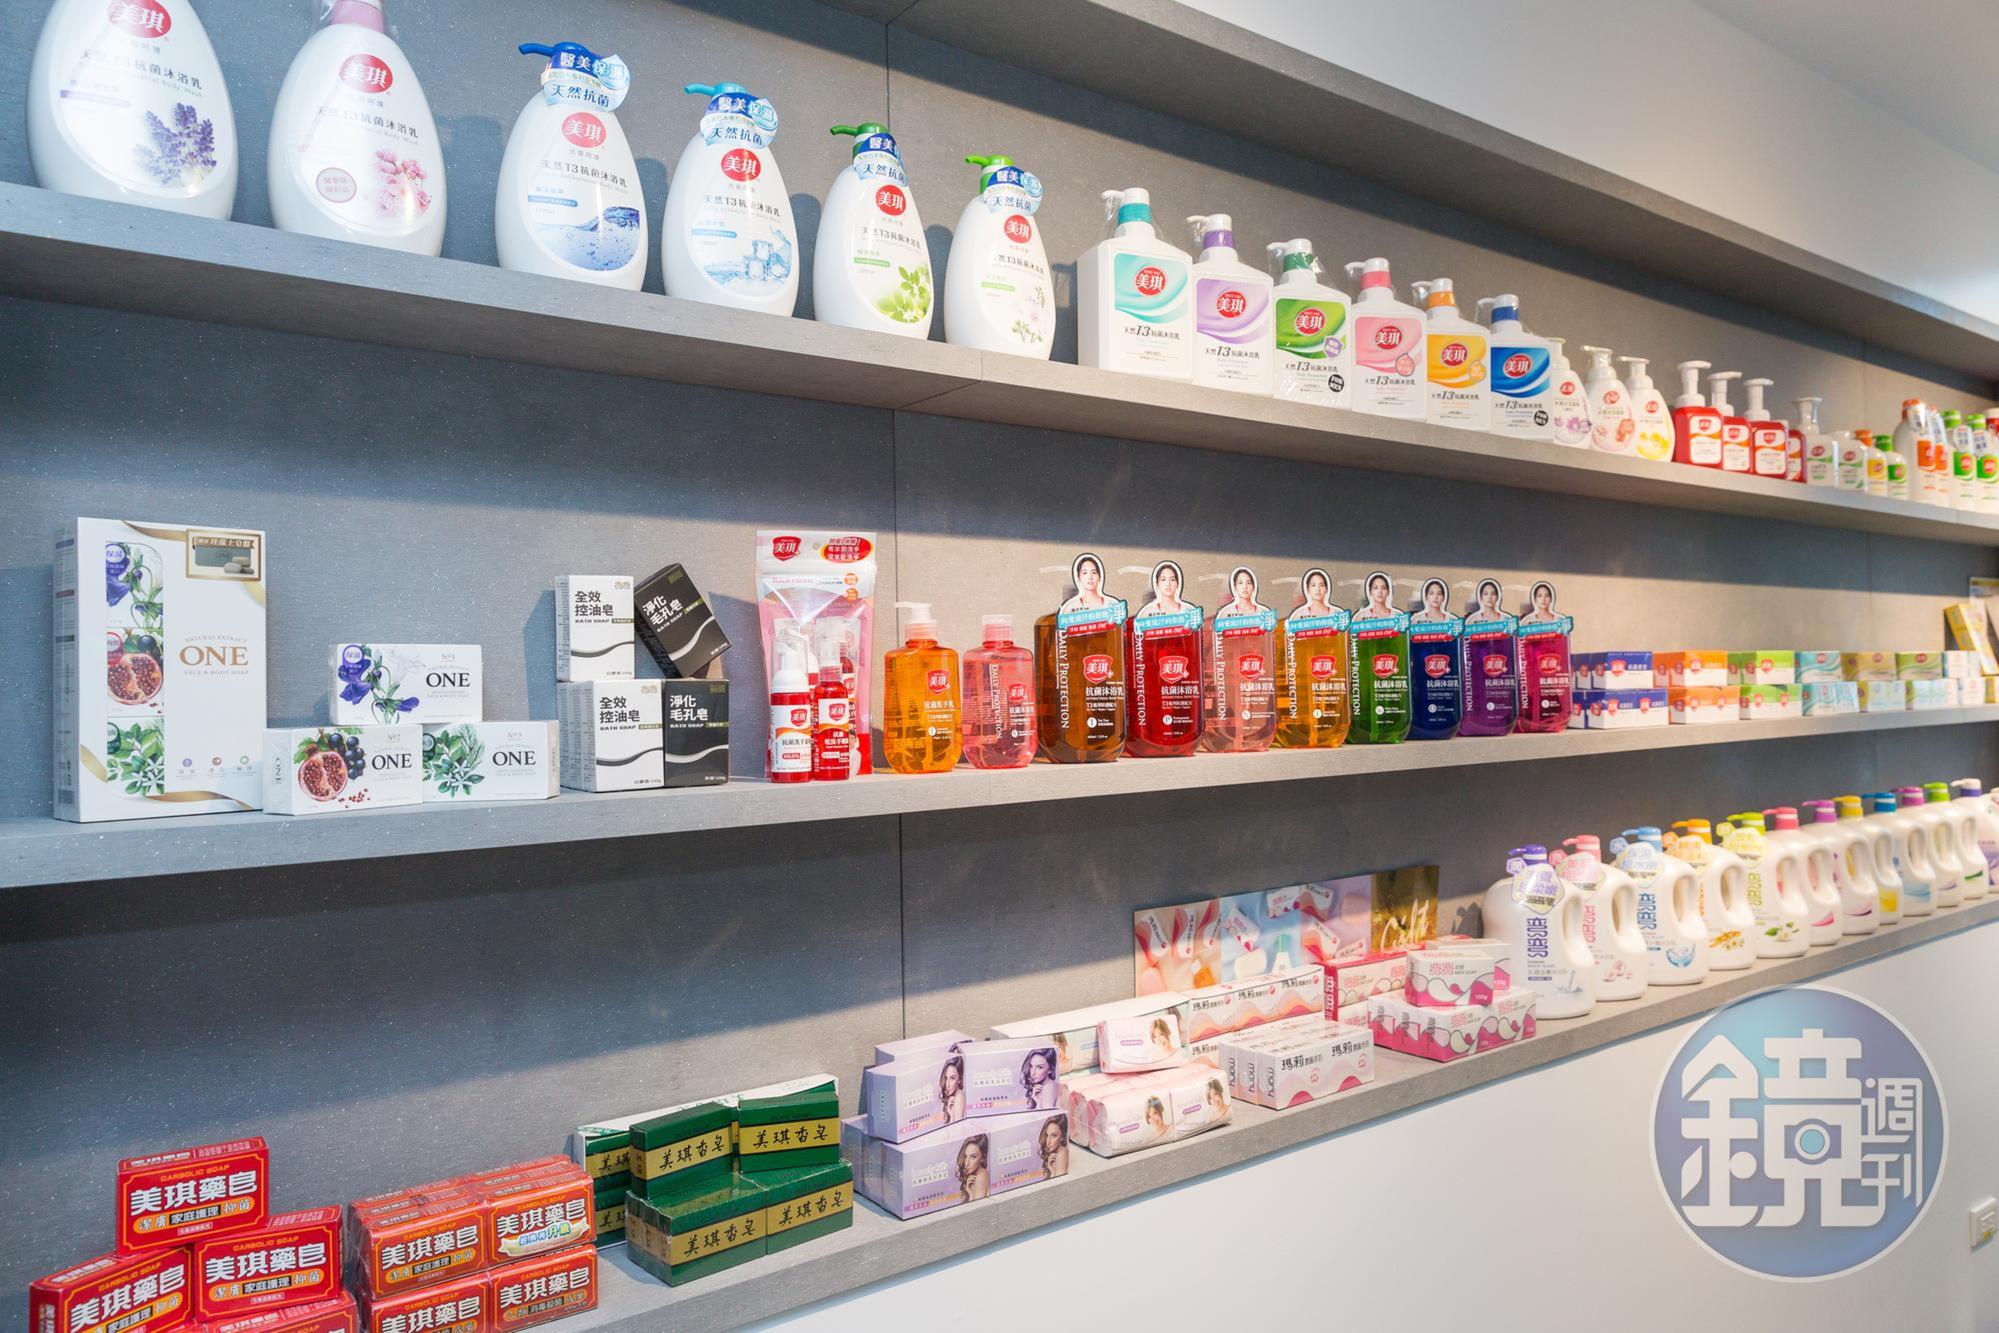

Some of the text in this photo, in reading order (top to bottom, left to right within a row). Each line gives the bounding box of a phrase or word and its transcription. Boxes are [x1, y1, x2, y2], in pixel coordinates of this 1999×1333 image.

[114, 2, 166, 33] 美琪
[551, 84, 611, 108] 天然抗菌
[565, 119, 603, 145] 美琪
[711, 126, 763, 147] 天然抗菌
[723, 156, 758, 177] 美琪
[862, 164, 907, 184] 天然抗菌
[877, 190, 904, 206] 美琪
[992, 195, 1033, 212] 天然抗菌
[1005, 220, 1031, 239] 美琪
[1136, 272, 1164, 291] 美琪
[1216, 297, 1245, 314] 美琪
[1298, 314, 1323, 330] 美琪
[1375, 331, 1402, 345] 美琪
[1441, 348, 1466, 362] 美琪
[1505, 360, 1529, 372] 美琪
[775, 542, 797, 554] 美琪
[575, 590, 602, 603] 全效
[643, 595, 668, 616] 淨化
[575, 604, 614, 617] 控油皂
[650, 599, 684, 626] 毛孔皂
[179, 646, 249, 666] ONE
[1241, 660, 1261, 671] 美琪
[1375, 660, 1395, 671] 美琪
[1428, 660, 1447, 671] 美琪
[1086, 661, 1109, 673] 美琪
[1162, 661, 1184, 673] 美琪
[1312, 661, 1333, 672] 美琪
[426, 672, 471, 688] ONE
[929, 675, 947, 685] 美琪
[1059, 631, 1070, 729] DAILY PROTECTION
[1135, 633, 1147, 726] DAILY PROTECTION
[1240, 682, 1275, 692] 抗菌沐浴乳
[1311, 682, 1347, 692] 抗菌沐浴乳
[1351, 661, 1361, 716] PROTECTION
[1464, 660, 1474, 712] PROTECTION
[1085, 686, 1124, 696] 抗菌沐浴乳
[1161, 685, 1200, 695] 抗菌沐浴乳
[1216, 661, 1227, 721] PROTECTION
[1288, 660, 1297, 719] PROTECTION
[599, 696, 628, 710] 全效
[670, 694, 697, 708] 淨化
[600, 709, 641, 724] 控油皂
[670, 708, 709, 721] 毛孔皂
[371, 753, 413, 771] ONE
[492, 751, 537, 767] ONE
[752, 1123, 829, 1149] 美琪香皂
[659, 1134, 725, 1171] 美琪香皂
[160, 1164, 230, 1182] CARBOLIC SOAP
[130, 1170, 258, 1217] 美琪藥皂
[170, 1205, 220, 1224] 家庭護理
[223, 1198, 251, 1213] 抑菌
[496, 1198, 587, 1238] 美琪藥皂
[779, 1190, 844, 1228] 美琪香皂
[403, 1221, 457, 1241] CARBOLIC SOAP
[684, 1217, 756, 1258] 美琪香皂
[232, 1236, 300, 1252] CARBOLIC SOAP
[382, 1224, 479, 1270] 美琪藥皂
[205, 1242, 327, 1284] 美琪藥皂
[98, 1262, 162, 1292] CARBOLIC SOAP
[244, 1277, 291, 1294] 家庭護理
[293, 1271, 320, 1285] 抑菌
[500, 1266, 590, 1310] 美琪藥皂
[70, 1263, 186, 1333] 美琪藥皂
[382, 1295, 481, 1333] 美琪藥皂
